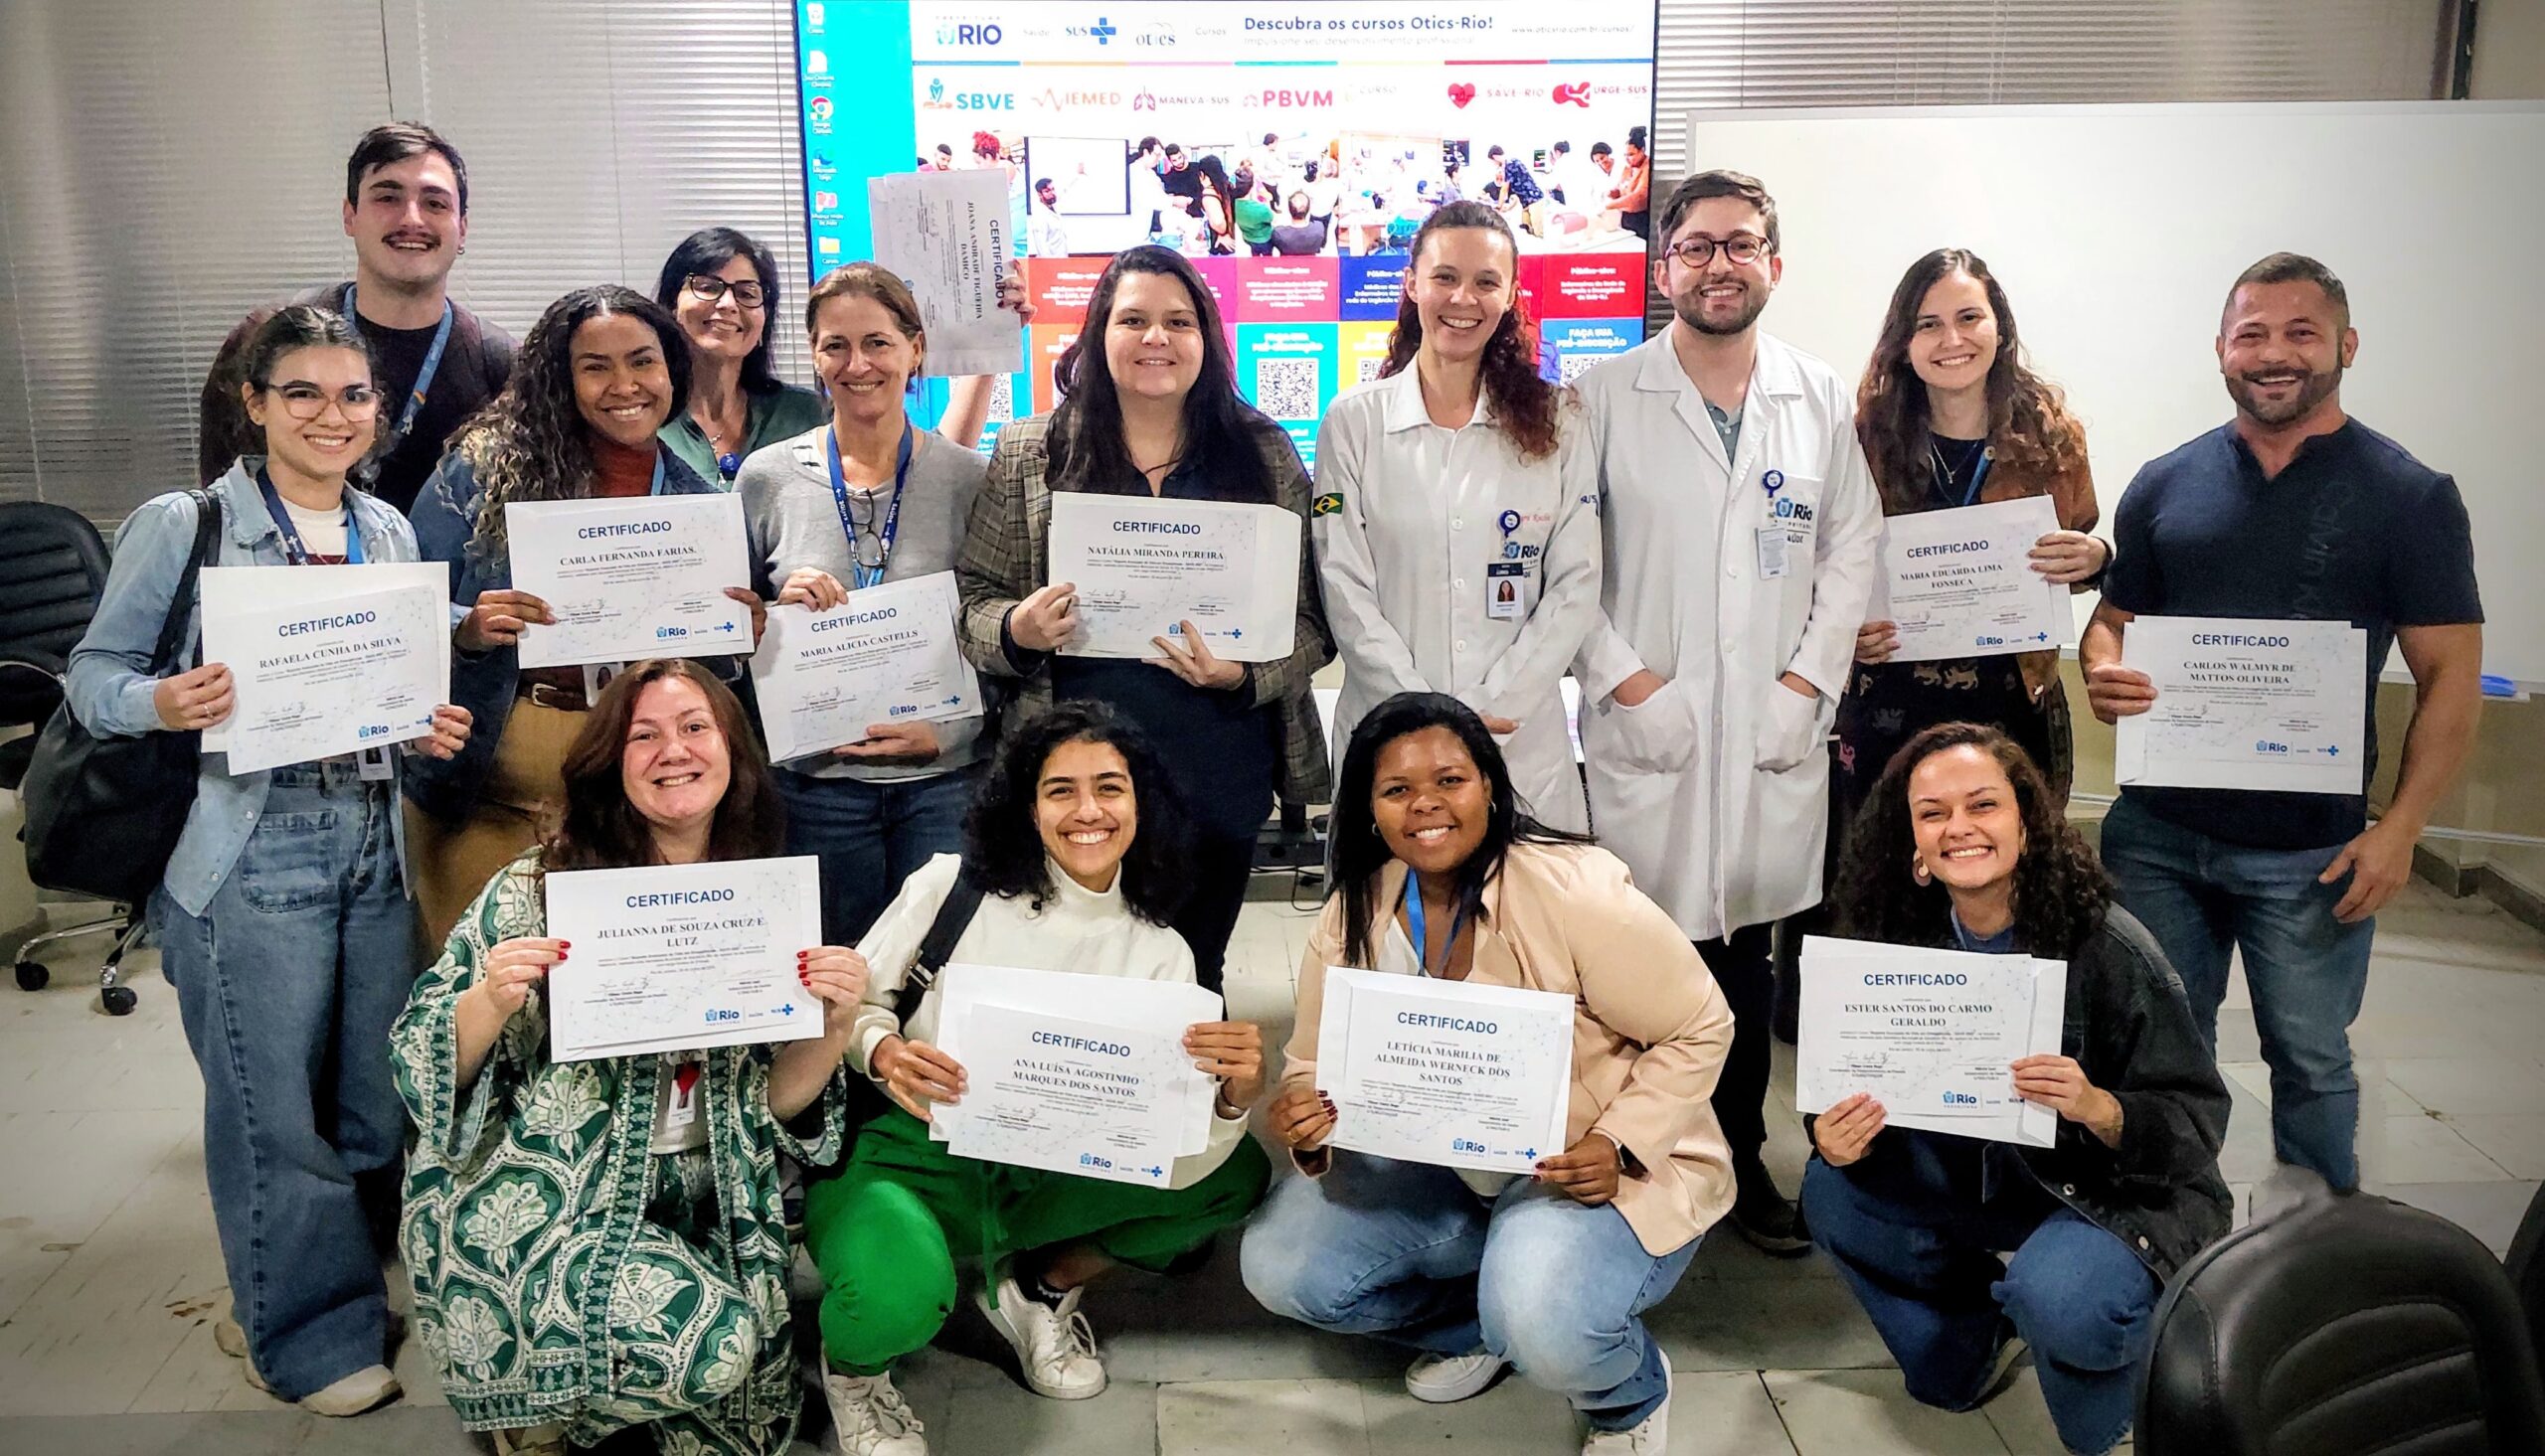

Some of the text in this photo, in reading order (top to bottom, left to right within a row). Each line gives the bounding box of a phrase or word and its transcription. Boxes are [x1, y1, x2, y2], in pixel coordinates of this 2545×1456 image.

[1245, 15, 1493, 31] Descubra os cursos Otics-Rio!
[958, 24, 1002, 45] RIO
[1066, 27, 1088, 36] SUS
[1195, 26, 1228, 36] Cursos
[1593, 85, 1647, 95] URGE-SUS
[956, 92, 1015, 110] SBVE
[1263, 89, 1333, 107] PBVM
[967, 202, 976, 232] JOANA
[1793, 504, 1812, 521] Rio
[578, 521, 672, 540] CERTIFICADO
[1112, 521, 1201, 535] CERTIFICADO
[1133, 548, 1180, 559] MIRANDA
[1182, 551, 1224, 560] PEREIRA
[1521, 545, 1540, 559] Rio
[1907, 540, 1989, 559] CERTIFICADO
[560, 556, 596, 566] CARLA
[599, 551, 655, 563] FERNANDA
[1901, 565, 2003, 581] MARIA EDUARDA LIMA
[1932, 578, 1973, 589] FONSECA
[278, 610, 377, 638] CERTIFICADO
[811, 607, 898, 633] CERTIFICADO
[668, 627, 687, 637] Rio
[800, 630, 919, 659] MARIA ALICIA CASTELLS
[1986, 636, 2003, 645] Rio
[2192, 634, 2290, 647] CERTIFICADO
[259, 636, 402, 669] RAFAELA CUNHA DA SILVA
[2183, 661, 2296, 673] CARLOS WALMYR DE
[2190, 673, 2290, 684] MATTOS OLIVEIRA
[900, 705, 918, 715] Rio
[371, 725, 389, 736] Rio
[2269, 742, 2288, 752] Rio
[626, 889, 735, 908] CERTIFICADO
[597, 926, 658, 939] JULIANNA
[661, 924, 678, 934] DE
[679, 921, 719, 933] SOUZA
[722, 917, 755, 929] CRUZ
[1864, 973, 1968, 986] CERTIFICADO
[719, 1009, 740, 1021] Rio
[1844, 1004, 1992, 1014] ESTER SANTOS DO CARMO
[1397, 1012, 1498, 1035] CERTIFICADO
[1890, 1018, 1947, 1027] GERALDO
[1031, 1031, 1131, 1057] CERTIFICADO
[1387, 1041, 1502, 1063] LETÍCIA MARILIA DE
[1013, 1058, 1139, 1085] ANA LUÍSA AGOSTINHO
[1374, 1053, 1511, 1078] ALMEIDA WERNECK DOS
[1013, 1070, 1136, 1097] MARQUES DOS SANTOS
[1419, 1072, 1463, 1086] SANTOS
[1956, 1093, 1977, 1104] Rio
[1465, 1141, 1485, 1153] Rio
[1093, 1156, 1112, 1169] Rio
